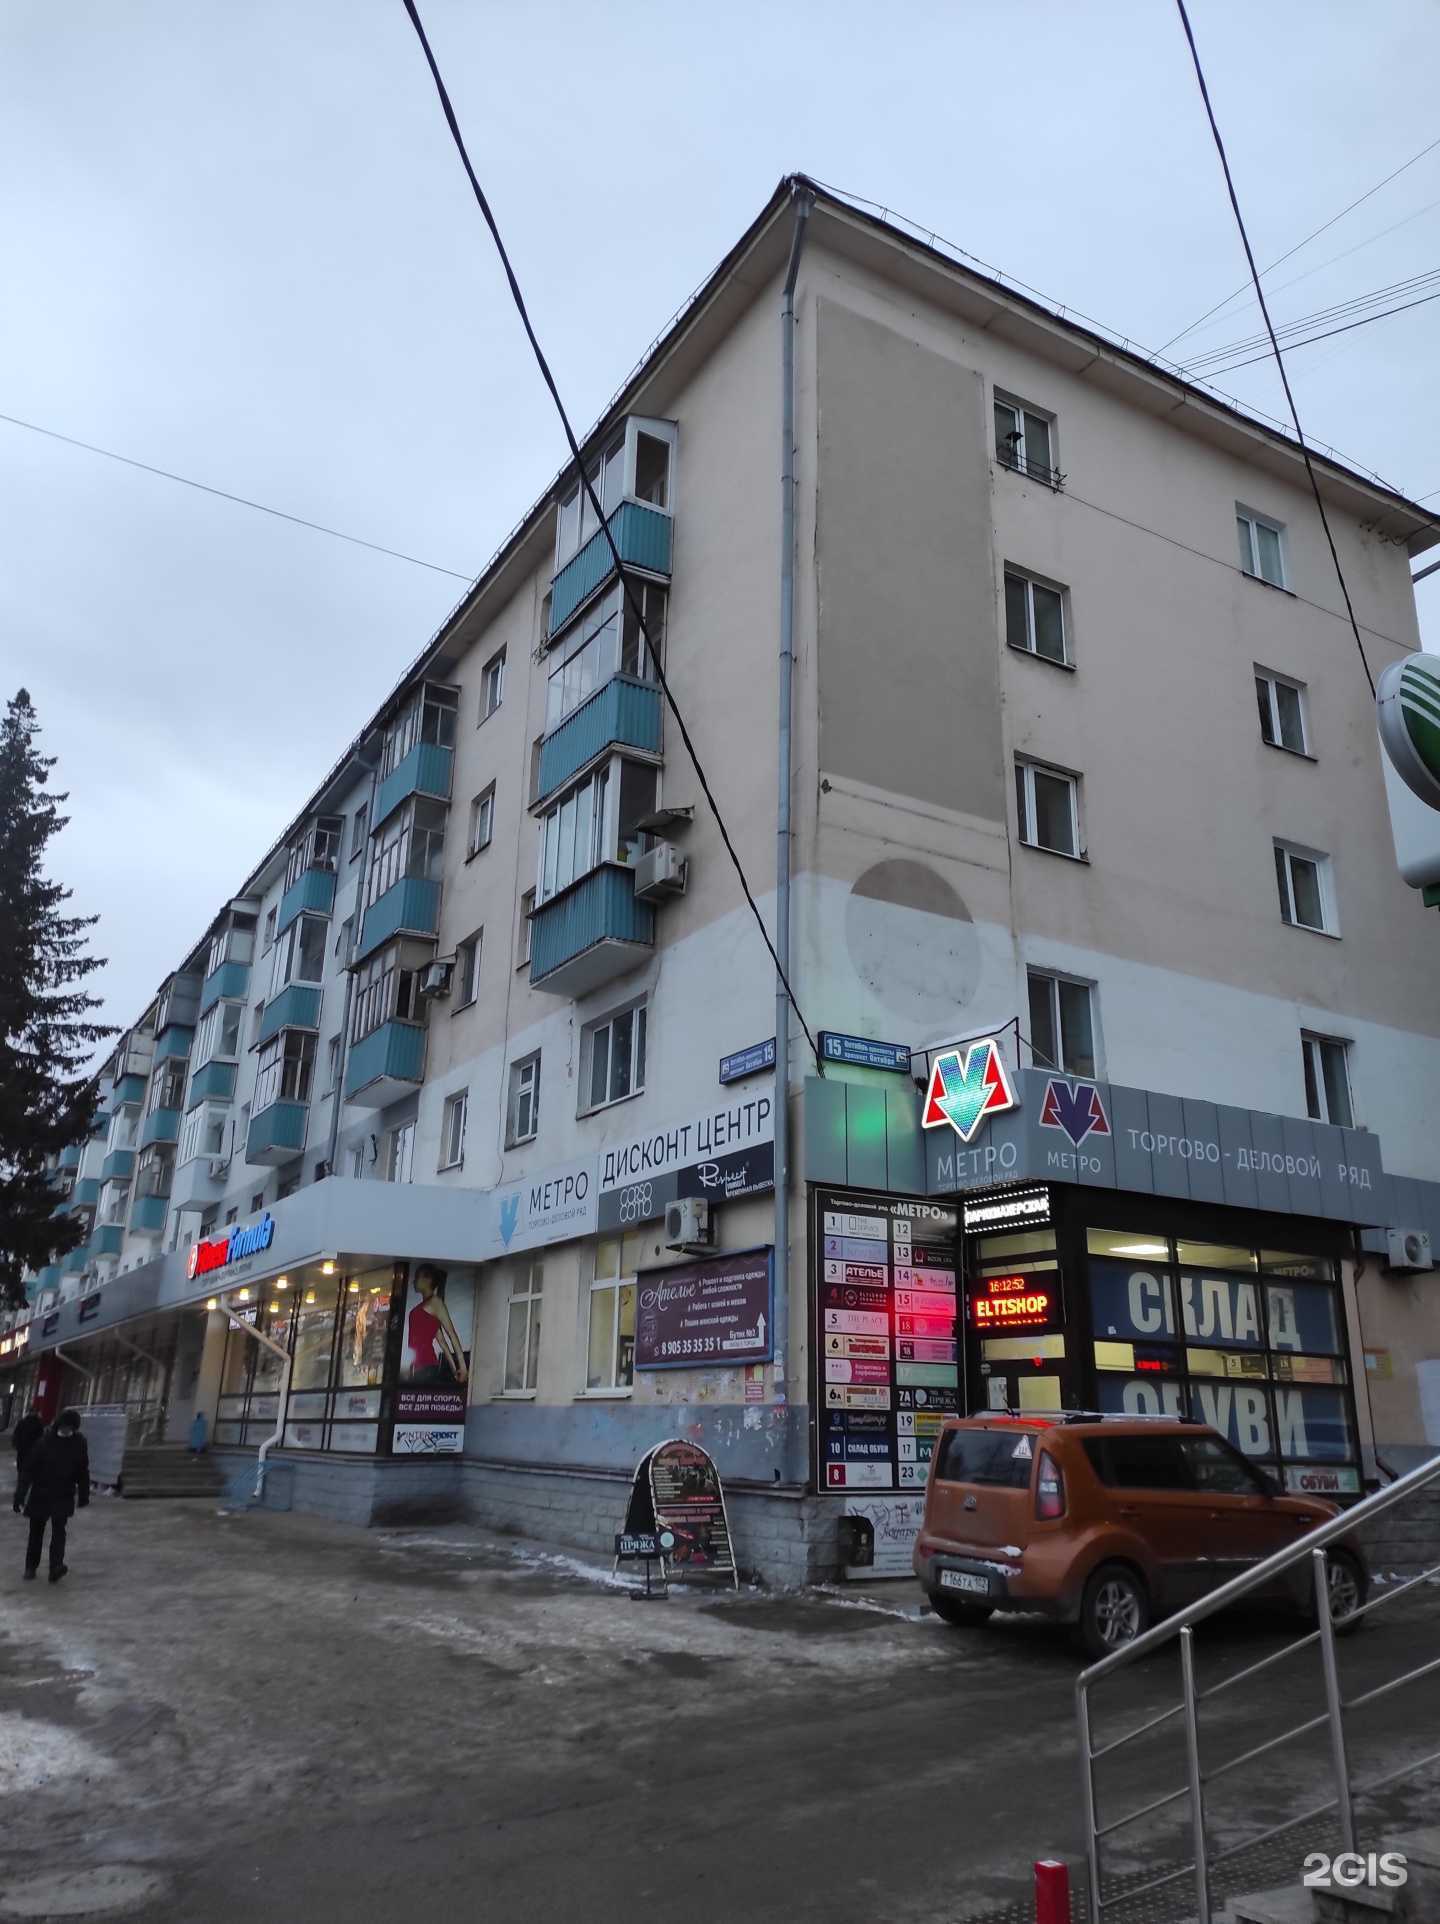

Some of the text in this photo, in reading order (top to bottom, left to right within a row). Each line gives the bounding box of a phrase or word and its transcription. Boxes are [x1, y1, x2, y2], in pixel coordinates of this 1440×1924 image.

[763, 1044, 774, 1062] 15
[827, 1039, 841, 1056] 15
[602, 1098, 771, 1189] ДИСКОНТ ЦЕНТР
[937, 1142, 1017, 1181] МЕТРО
[1047, 1151, 1101, 1174] МЕТРО
[1237, 1147, 1322, 1179] ДЕЛОВОЙ
[1338, 1163, 1372, 1191] РЯД
[697, 1162, 747, 1197] Respect
[529, 1171, 589, 1215] МЕТРО
[831, 1215, 836, 1227] 1
[897, 1223, 908, 1234] 12
[830, 1240, 837, 1250] 2
[897, 1246, 909, 1258] 13
[831, 1264, 837, 1275] 3
[846, 1266, 884, 1278] АТЕЛЬЕ
[897, 1270, 909, 1281] 14
[639, 1280, 697, 1312] Ателье
[897, 1293, 910, 1305] 15
[976, 1296, 1048, 1317] ELTISHOP
[1128, 1271, 1303, 1352] СКЛАД
[831, 1313, 838, 1324] 5
[661, 1341, 667, 1356] 8
[667, 1340, 681, 1355] 905
[681, 1339, 692, 1354] 35
[693, 1337, 703, 1353] 35
[704, 1336, 714, 1352] 35
[831, 1337, 839, 1349] 6
[401, 1394, 416, 1402] ВСЕ
[416, 1394, 432, 1403] ДЛЯ
[398, 1403, 413, 1412] ВСЕ
[413, 1403, 430, 1412] ДЛЯ
[901, 1415, 913, 1427] 19
[831, 1442, 841, 1454] 10
[847, 1444, 889, 1455] СКЛАД ОБУВИ
[902, 1444, 911, 1455] 17
[901, 1467, 914, 1478] 23
[1300, 1474, 1340, 1490] ОБУВИ
[620, 1540, 656, 1550] ПРЯЖА
